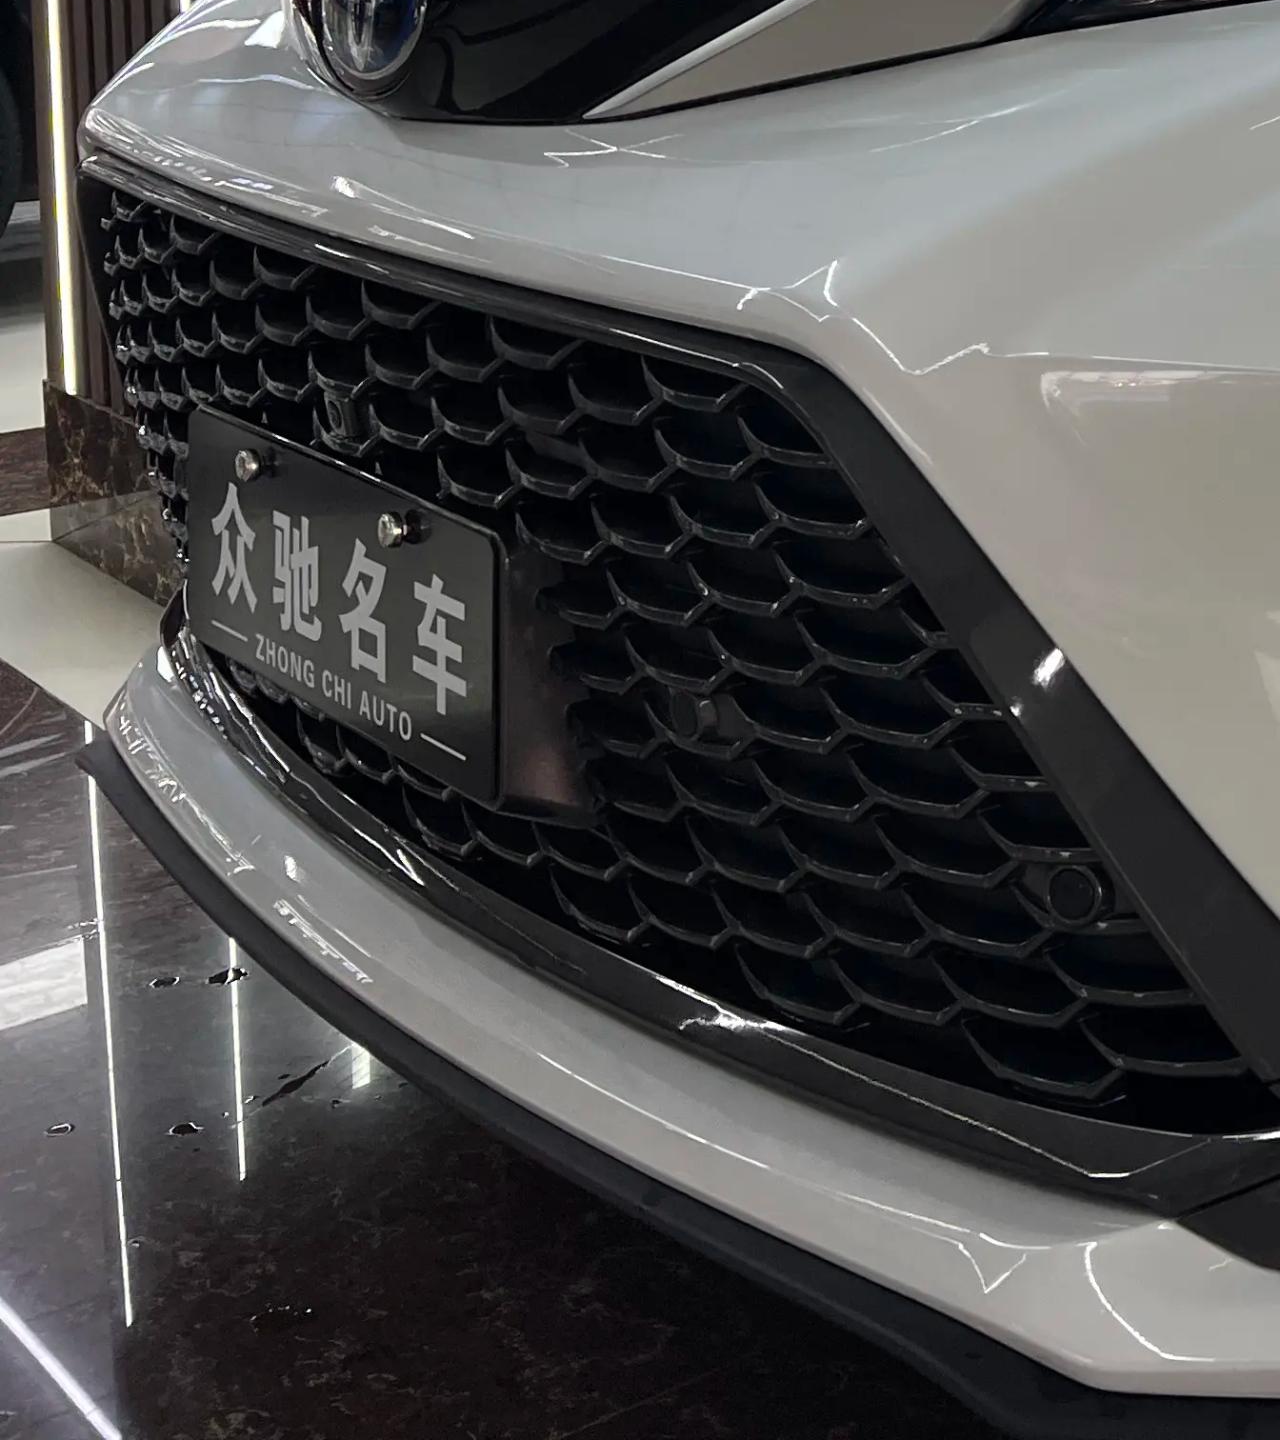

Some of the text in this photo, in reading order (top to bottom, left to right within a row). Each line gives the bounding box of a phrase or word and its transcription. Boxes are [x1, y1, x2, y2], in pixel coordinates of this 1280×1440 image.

[211, 482, 468, 716] 众驰名车
[254, 633, 414, 743] ZHONG CHI AUTO
